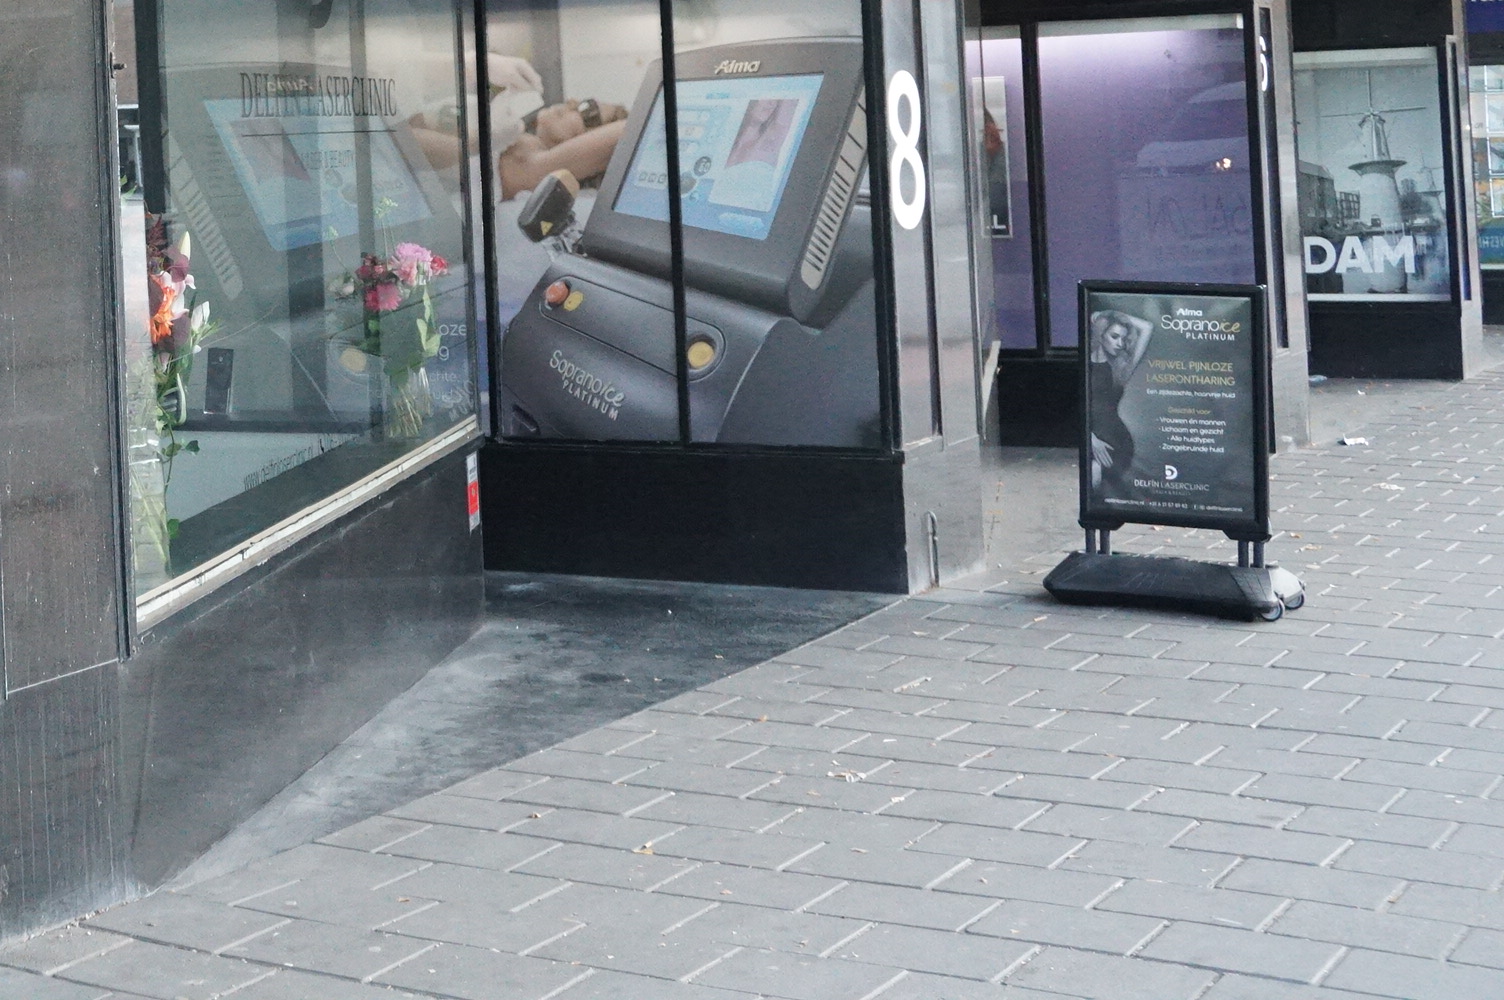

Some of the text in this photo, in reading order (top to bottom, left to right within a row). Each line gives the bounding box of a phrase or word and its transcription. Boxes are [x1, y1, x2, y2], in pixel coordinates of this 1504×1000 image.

[715, 60, 760, 74] Alma
[887, 69, 926, 231] 8
[1303, 236, 1416, 273] DAM
[1177, 308, 1203, 316] Alma
[1185, 332, 1235, 341] PLATINUM
[1148, 360, 1234, 372] VRIJWEL PIJNLOZE
[1146, 373, 1236, 386] LASERONTHARING
[562, 379, 619, 420] PLATINUM
[1133, 479, 1210, 491] DELFIN LASERCLINIC
